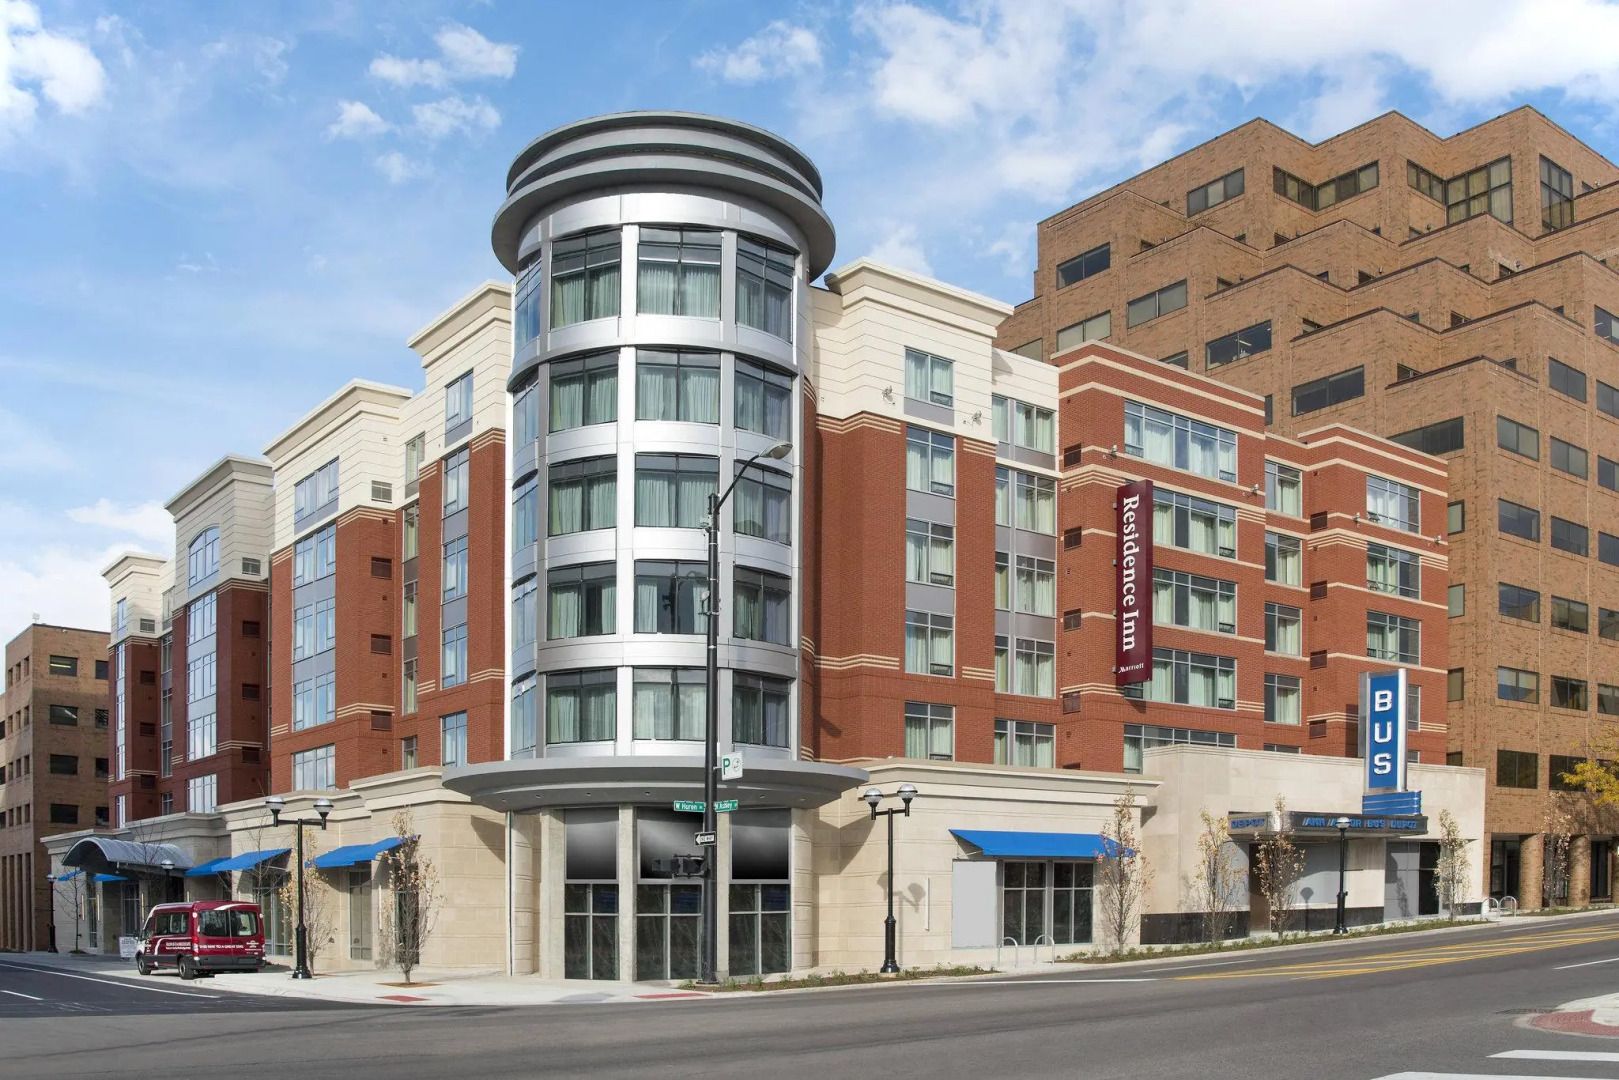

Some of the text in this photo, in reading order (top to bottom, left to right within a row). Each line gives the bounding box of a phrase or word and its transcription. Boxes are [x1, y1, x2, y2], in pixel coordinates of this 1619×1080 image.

[1123, 494, 1139, 652] Residence Inn
[1119, 663, 1144, 673] Marriott
[1373, 689, 1393, 775] BUS
[723, 758, 731, 775] P
[1230, 817, 1265, 829] DEPOT
[1329, 819, 1362, 828] AOR
[1390, 821, 1417, 829] DEPOT
